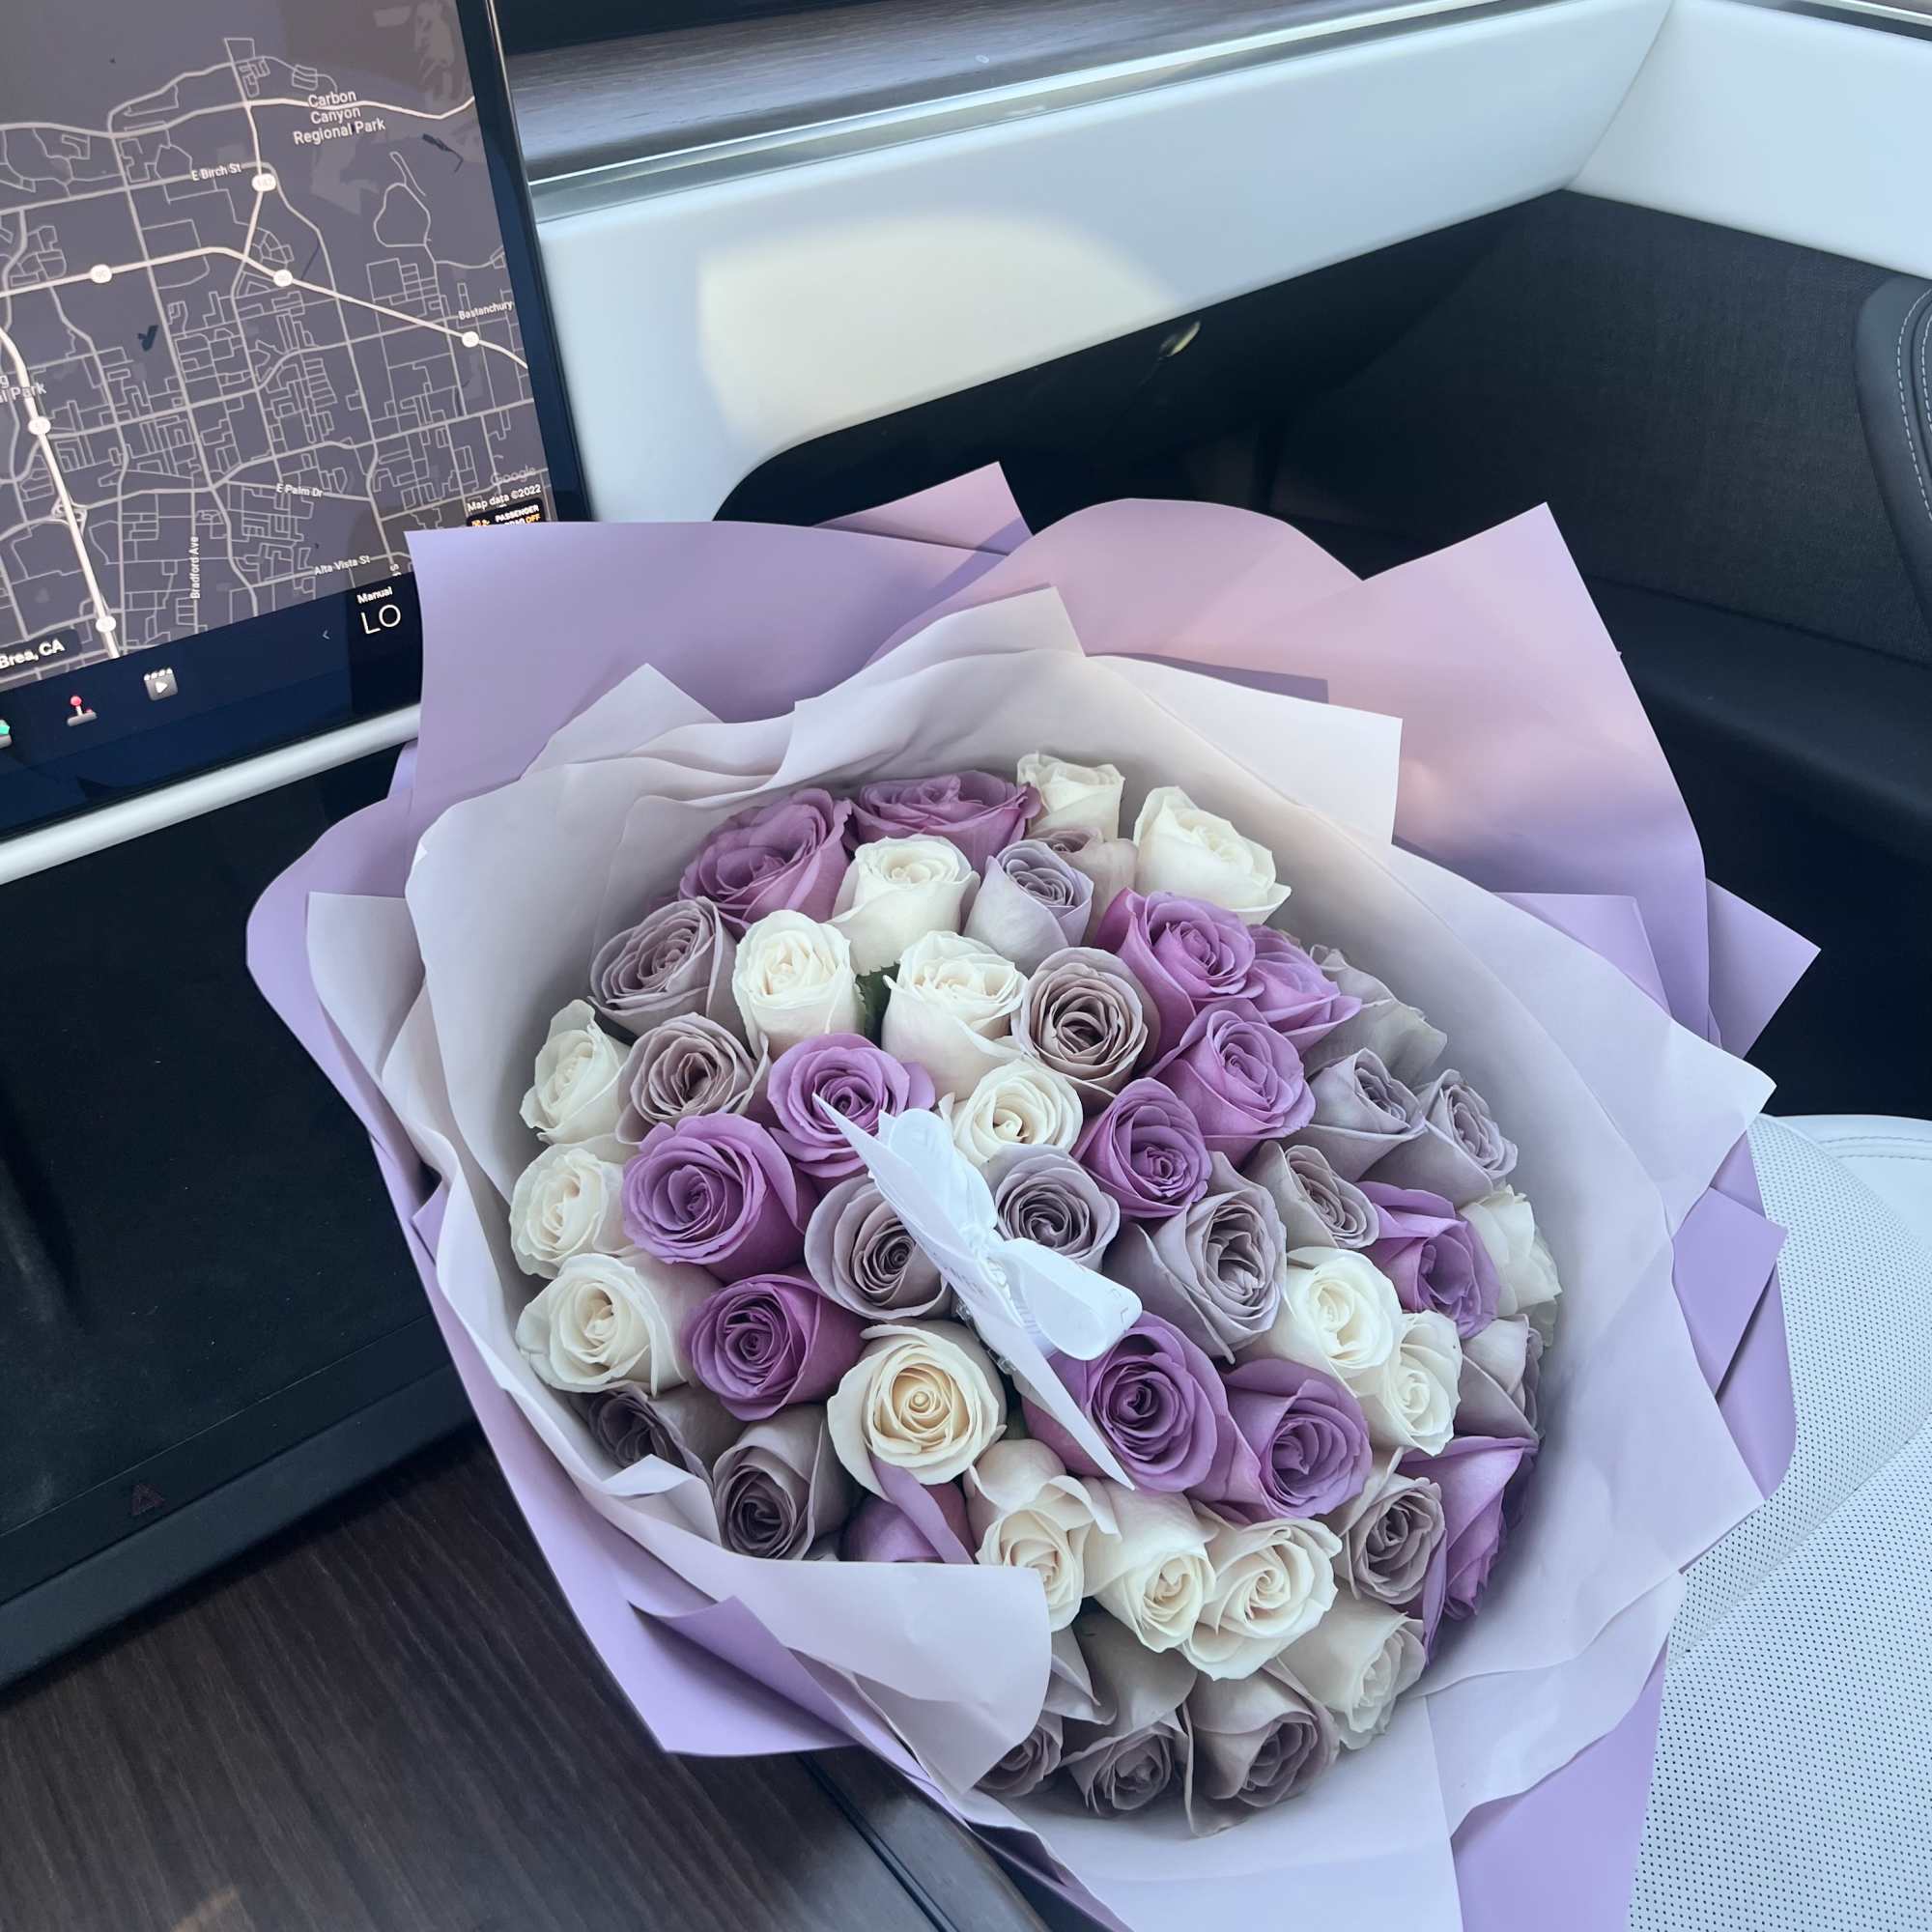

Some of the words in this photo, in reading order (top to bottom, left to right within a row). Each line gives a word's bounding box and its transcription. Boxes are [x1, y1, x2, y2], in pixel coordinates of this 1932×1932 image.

[308, 91, 356, 107] Carbon
[310, 107, 361, 124] Canyon
[293, 122, 353, 145] Regional
[354, 118, 386, 134] Park
[191, 170, 199, 181] E
[199, 165, 228, 180] Birch
[229, 162, 242, 173] St
[458, 301, 513, 320] Bastanchury
[11, 383, 47, 401] Park
[490, 465, 536, 485] Google
[276, 483, 283, 493] E
[285, 484, 310, 496] Palm
[312, 487, 324, 497] Dr
[467, 499, 488, 512] Map
[489, 494, 510, 506] data
[495, 504, 539, 523] PASSENGER
[526, 513, 541, 525] OFF
[188, 536, 200, 555] Ave
[314, 564, 333, 575] Alta
[333, 559, 357, 570] Vista
[358, 554, 370, 565] St
[189, 556, 201, 599] Bradford
[356, 586, 393, 604] Manual
[360, 604, 401, 634] LO
[39, 639, 66, 656] CA
